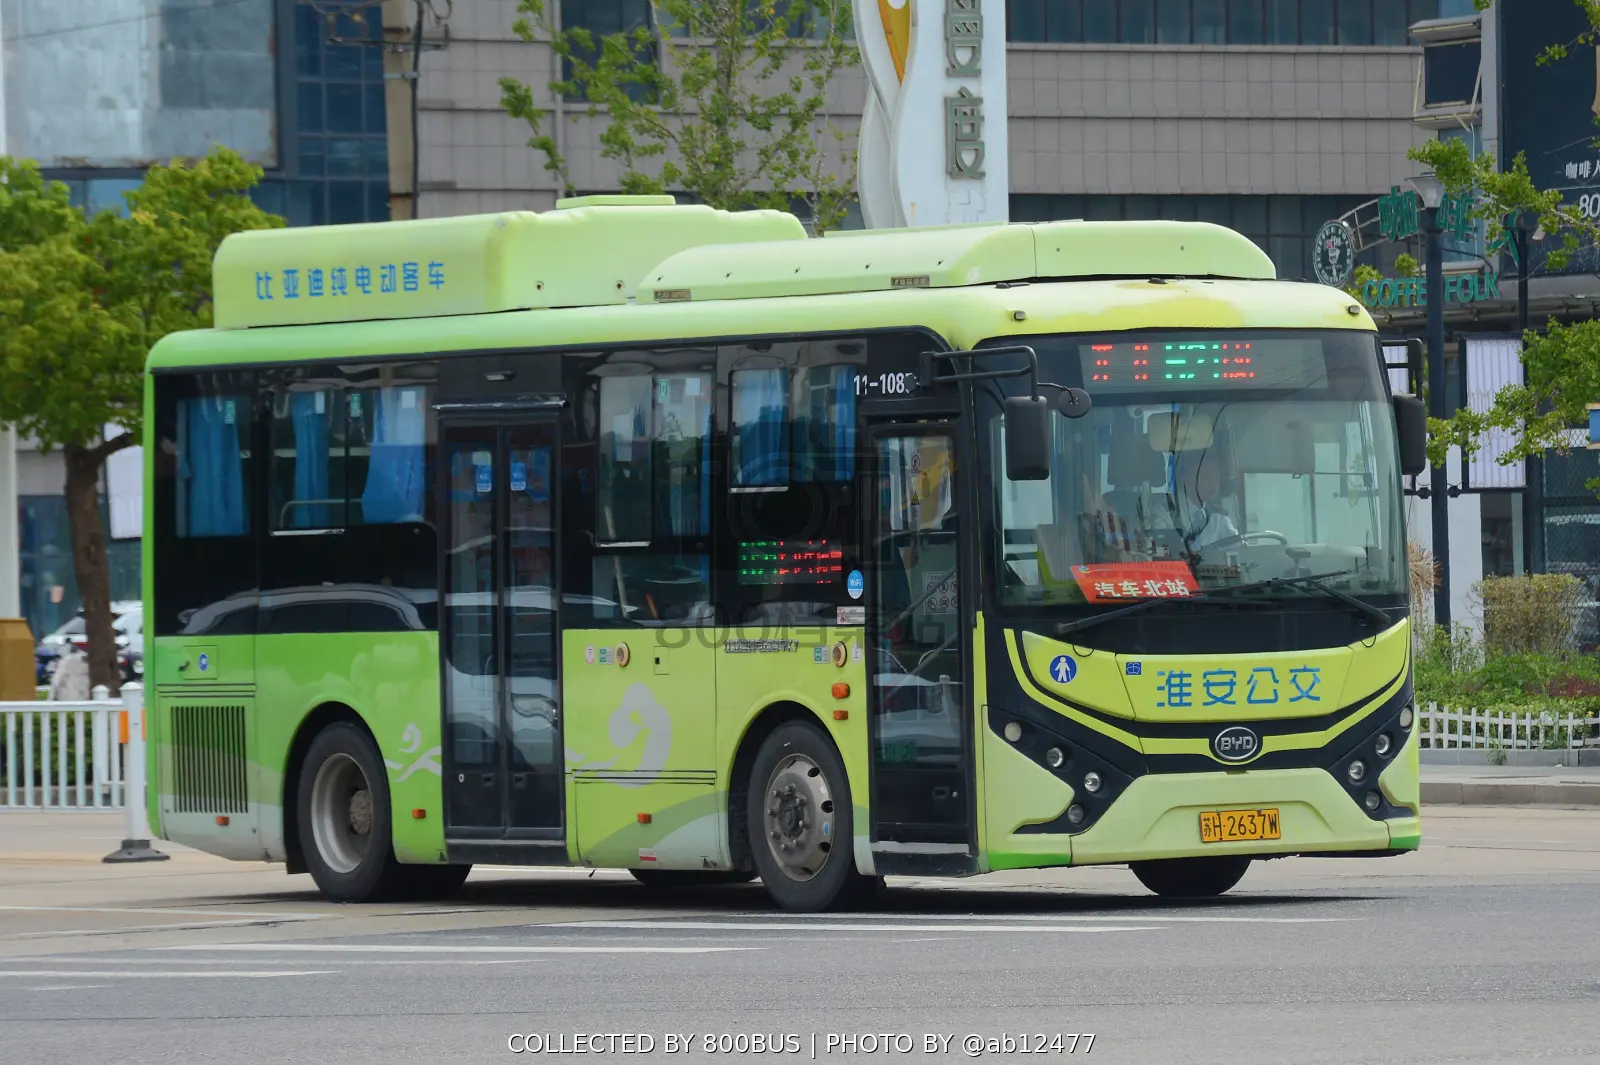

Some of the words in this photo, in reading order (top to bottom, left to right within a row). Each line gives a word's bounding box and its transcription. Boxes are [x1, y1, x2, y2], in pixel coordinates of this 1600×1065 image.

[256, 261, 445, 300] 比亚迪纯电动客车
[1445, 271, 1500, 304] FOLK
[853, 372, 920, 395] 11-108
[1094, 579, 1190, 597] 汽车北站
[1157, 664, 1321, 707] 淮安公交
[1220, 736, 1253, 751] BYD
